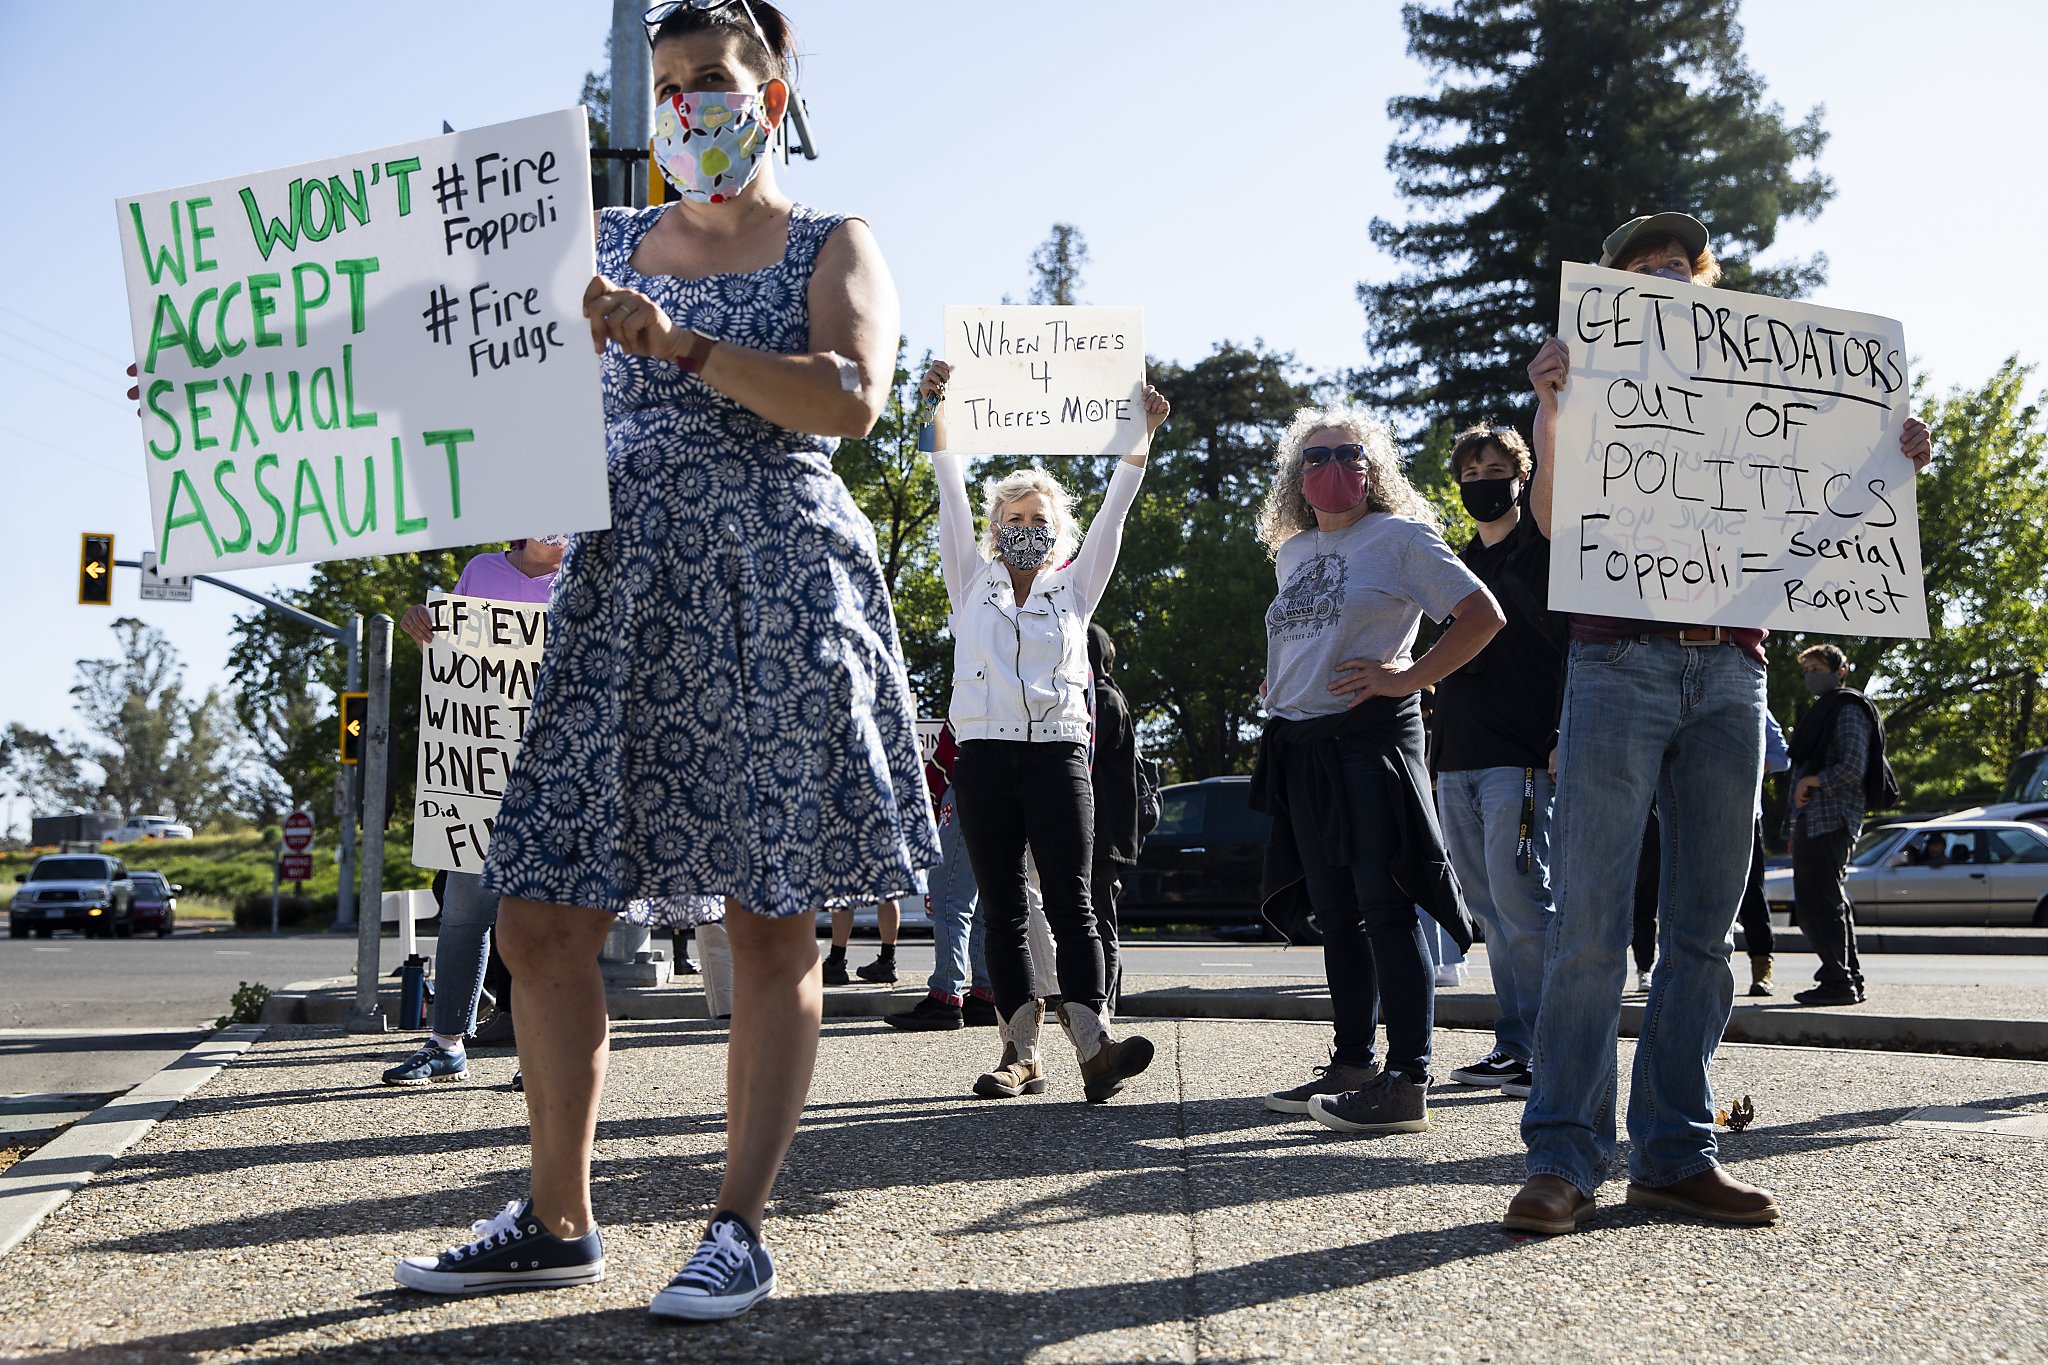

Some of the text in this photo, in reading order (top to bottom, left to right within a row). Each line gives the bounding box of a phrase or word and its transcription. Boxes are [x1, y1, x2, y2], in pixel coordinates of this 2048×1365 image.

[432, 150, 559, 214] #Fire
[129, 156, 422, 286] WE WON'T
[444, 199, 558, 255] Foppoli
[144, 256, 380, 374] ACCEPT
[1576, 286, 1903, 394] GET PREDATORS
[469, 320, 565, 378] Fudge
[1030, 360, 1052, 394] 4
[1606, 377, 1818, 440] OUT OF
[160, 428, 475, 566] ASSAULT
[1602, 441, 1897, 528] POLITICS
[1579, 513, 1730, 600] Foppoli
[428, 599, 468, 636] IF
[1286, 606, 1314, 617] RIVER
[1783, 573, 1909, 622] Rapist
[425, 694, 506, 741] WINE
[419, 800, 461, 820] Did
